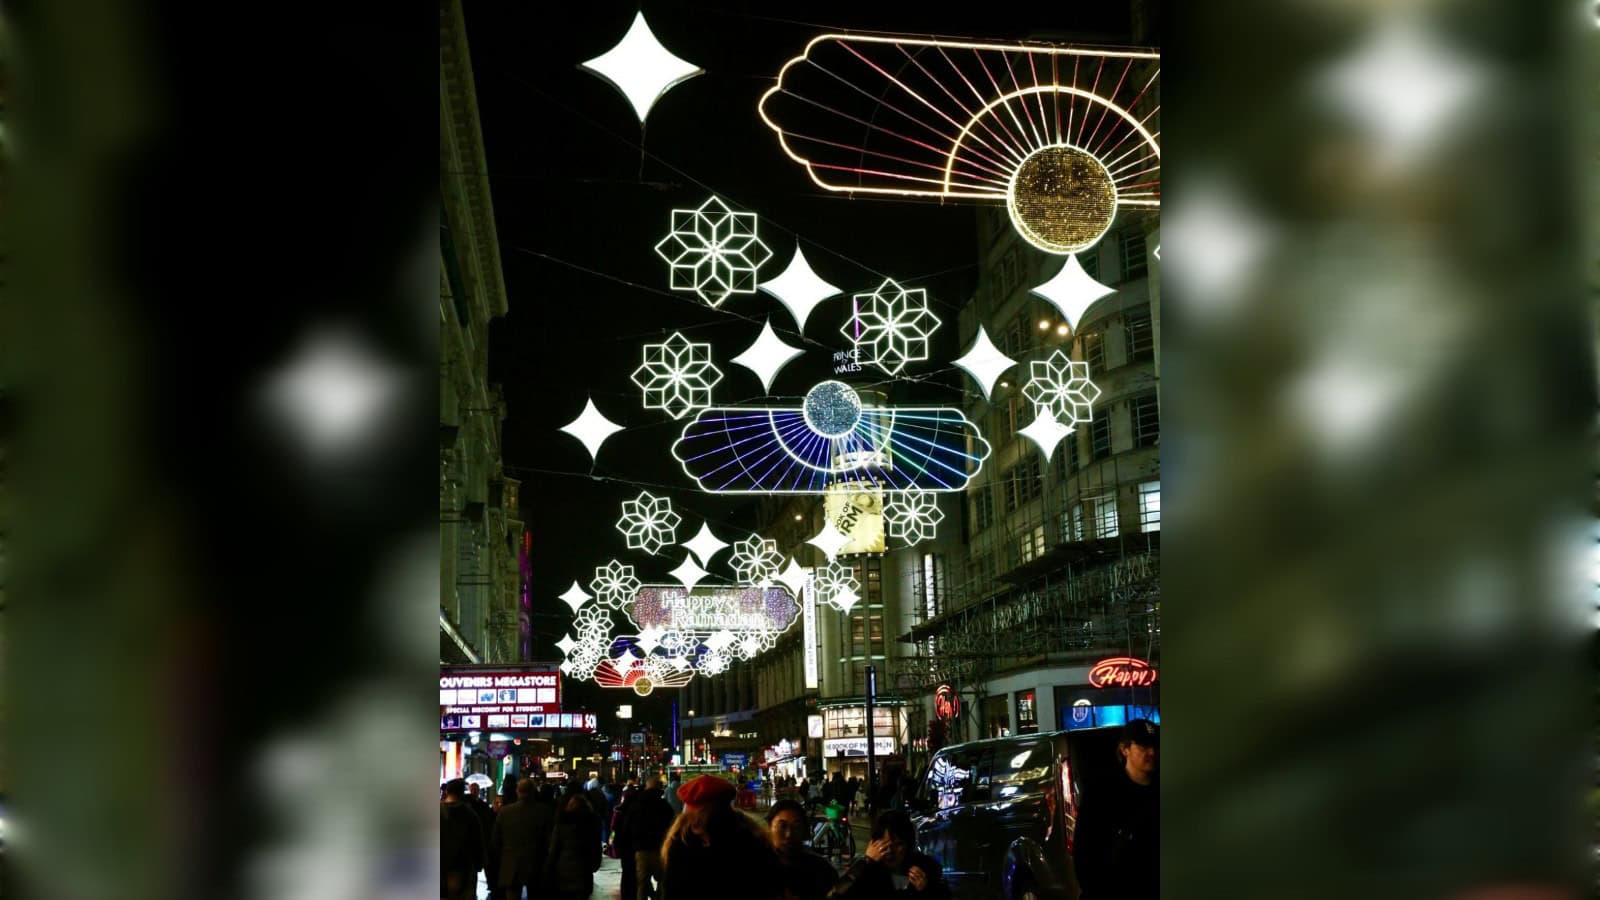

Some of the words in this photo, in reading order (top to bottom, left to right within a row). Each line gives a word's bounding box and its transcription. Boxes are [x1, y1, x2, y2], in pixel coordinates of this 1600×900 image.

[834, 363, 862, 374] WALES
[661, 590, 728, 610] Happy
[494, 675, 557, 687] MEGASTORE
[1095, 666, 1149, 687] Happy
[515, 705, 544, 713] STUDENTS
[848, 742, 858, 750] OF
